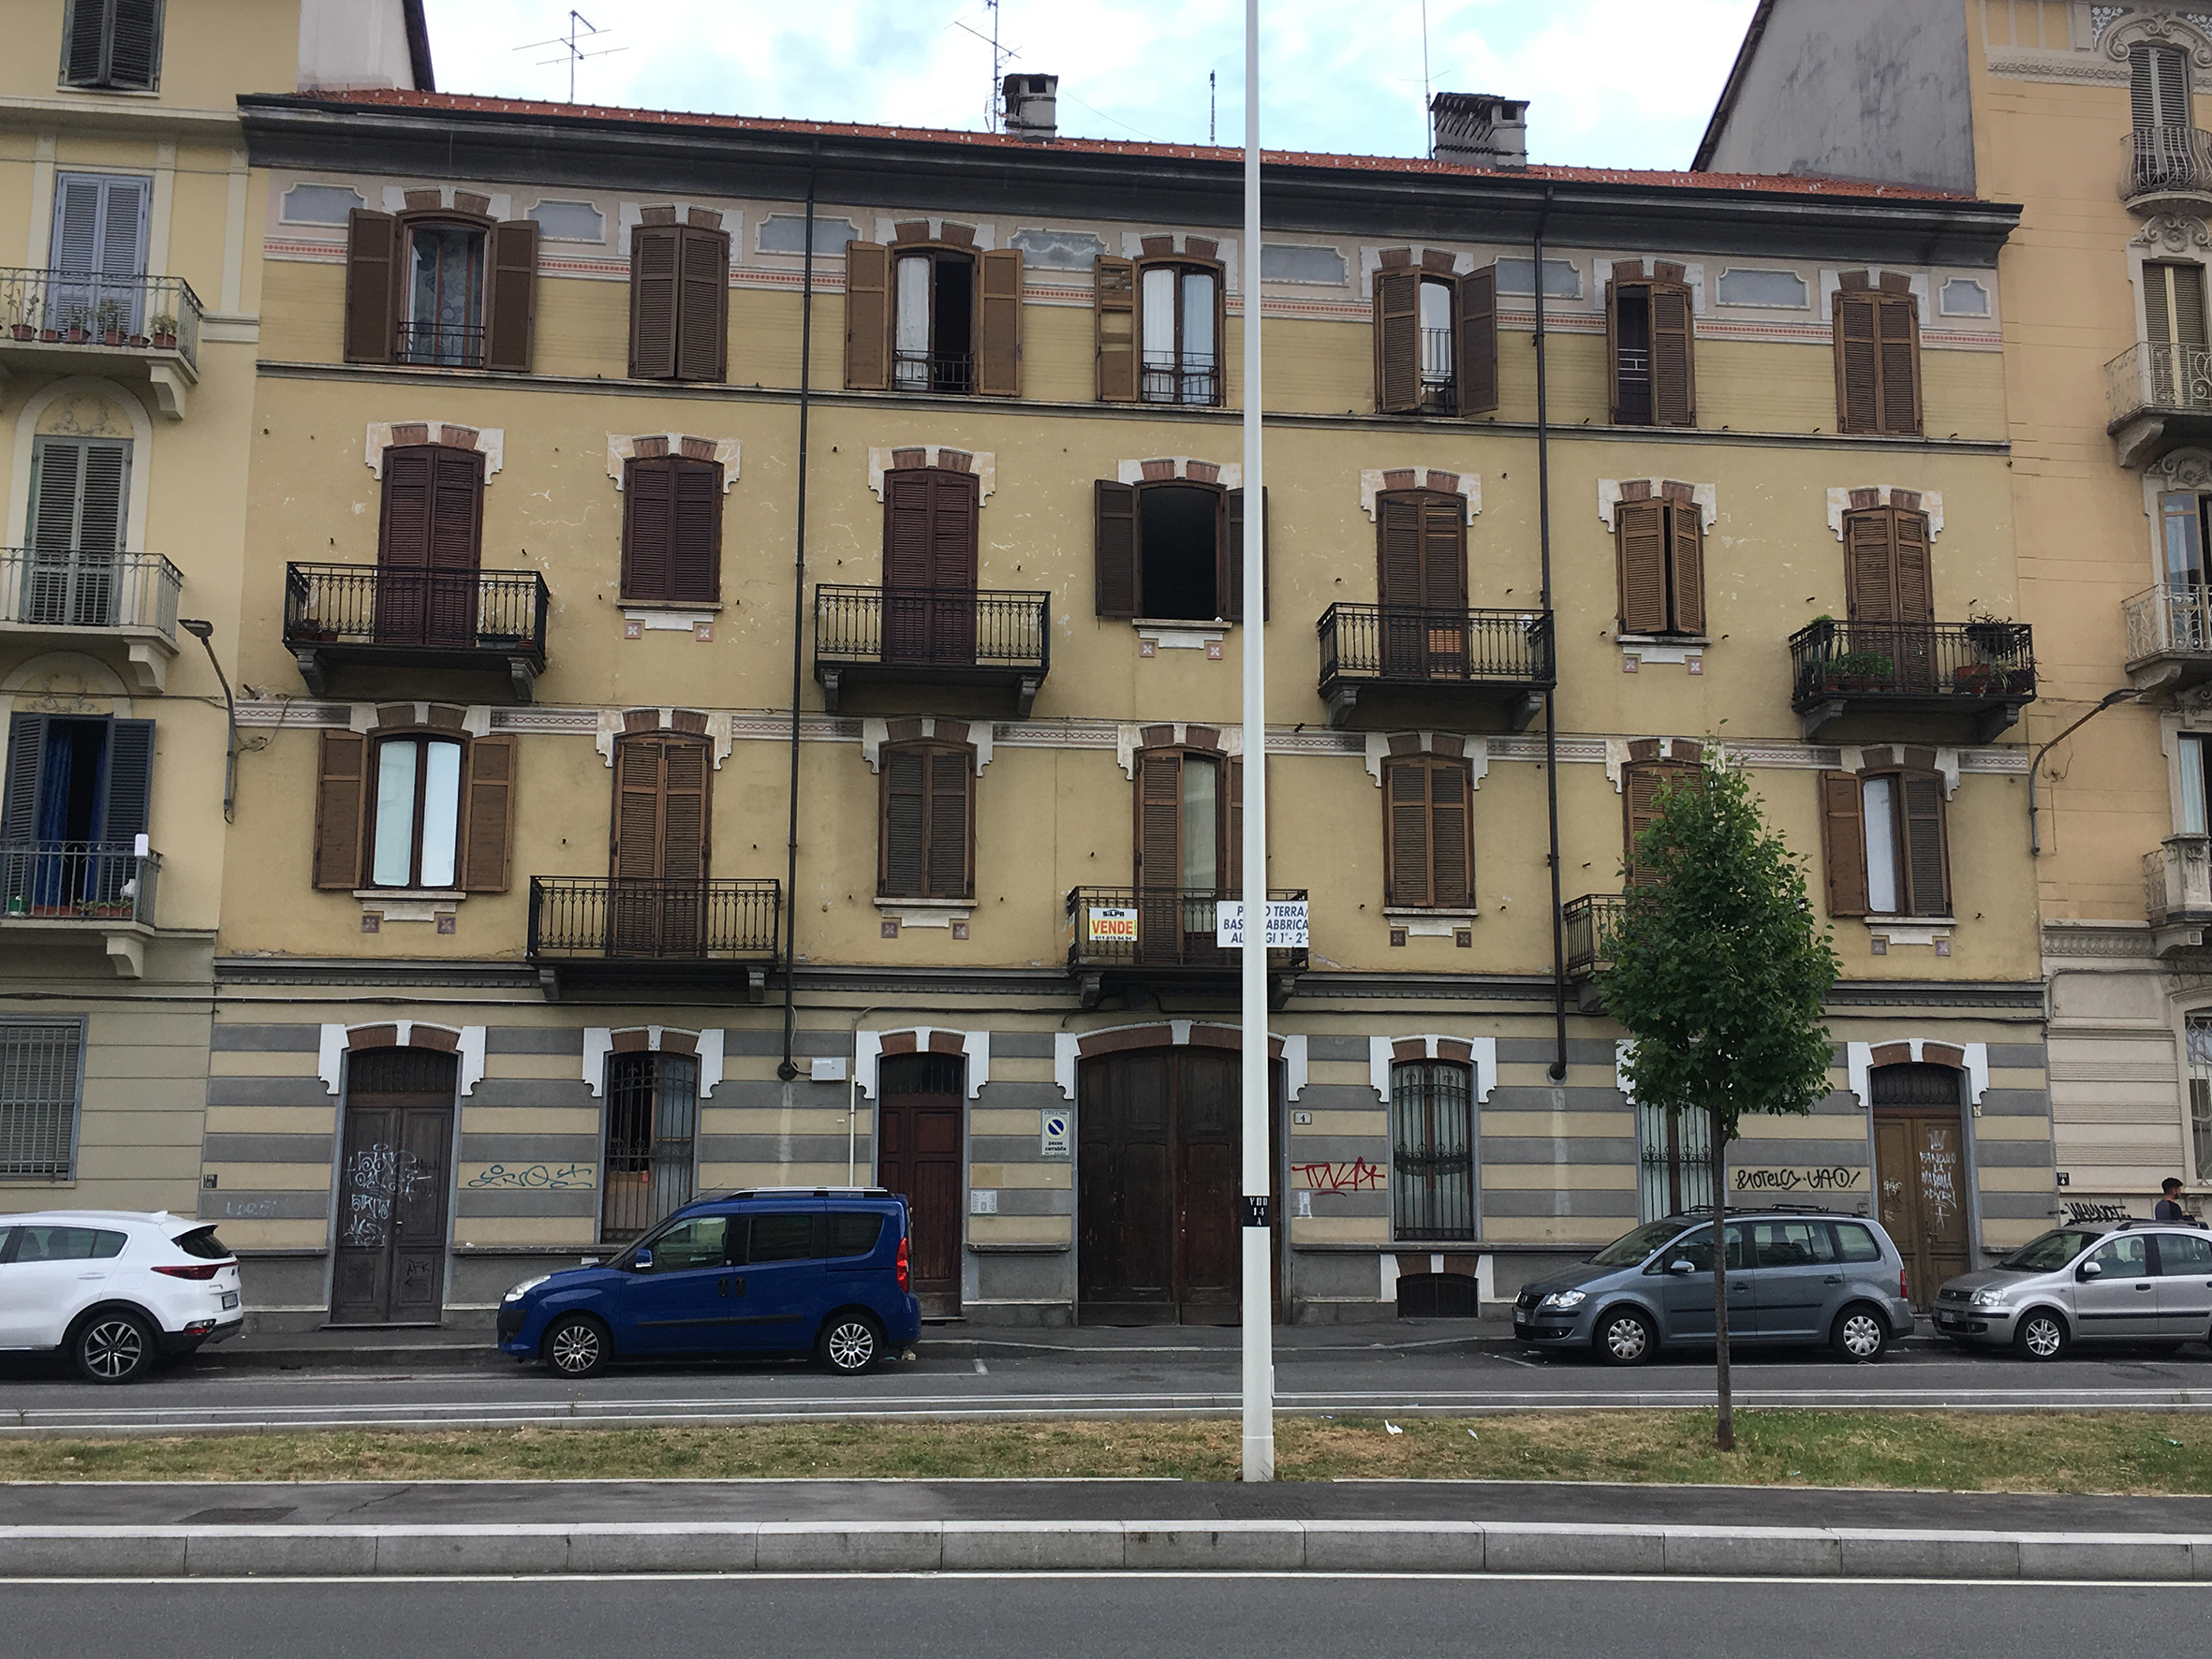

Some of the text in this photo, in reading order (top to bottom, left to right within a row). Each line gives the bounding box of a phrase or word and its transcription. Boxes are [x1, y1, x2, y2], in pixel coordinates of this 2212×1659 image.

[1092, 920, 1133, 934] VENDE
[1266, 919, 1309, 930] ABBRICA
[1256, 1216, 1262, 1226] A
